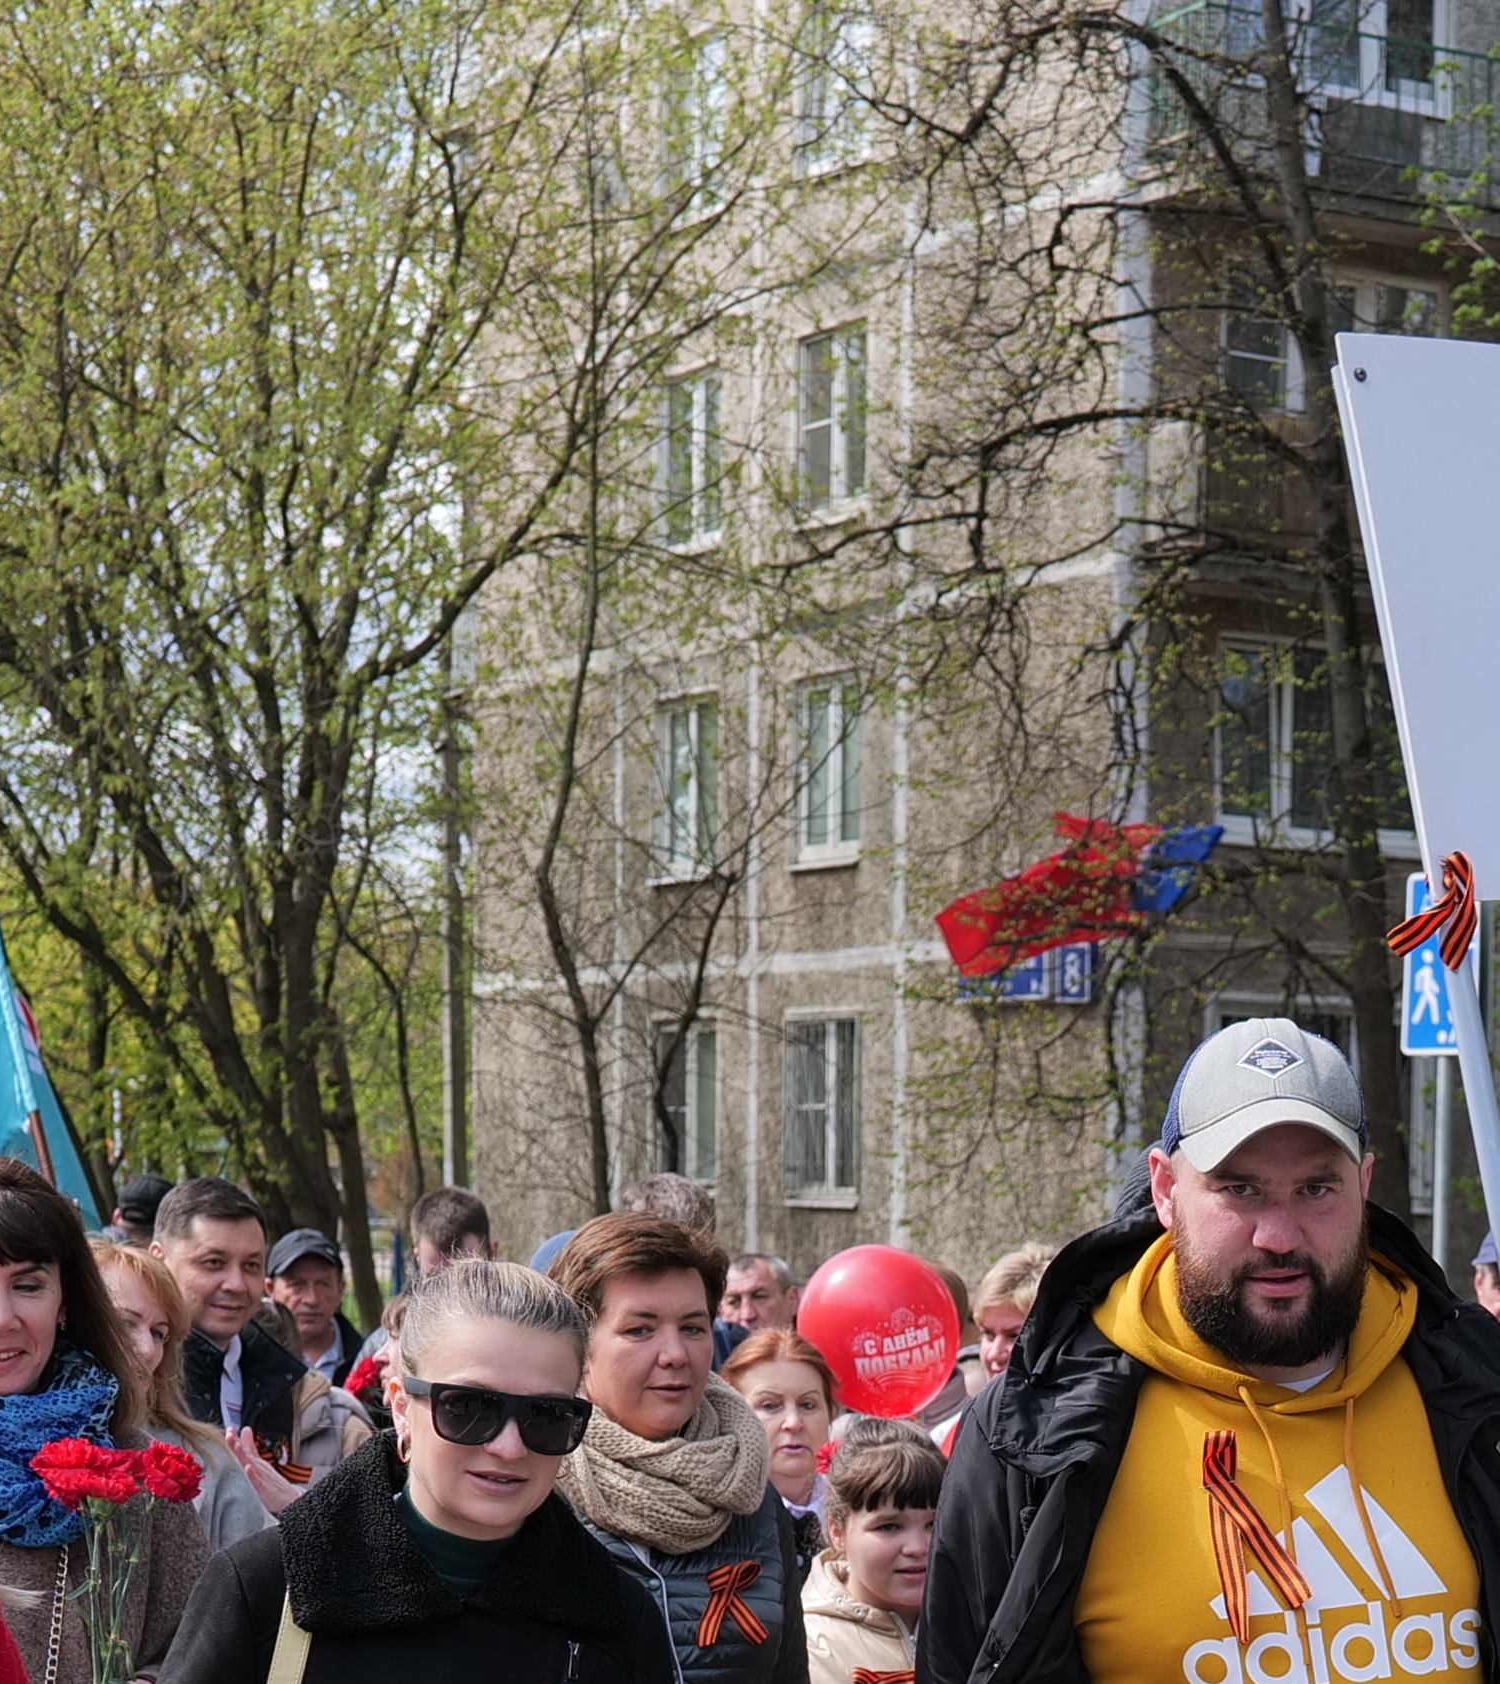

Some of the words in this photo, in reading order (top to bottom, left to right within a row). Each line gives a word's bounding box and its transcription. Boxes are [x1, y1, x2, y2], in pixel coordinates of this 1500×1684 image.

[1064, 951, 1081, 994] 8
[853, 1335, 946, 1380] ПОБЕДЫ!
[863, 1339, 878, 1356] С
